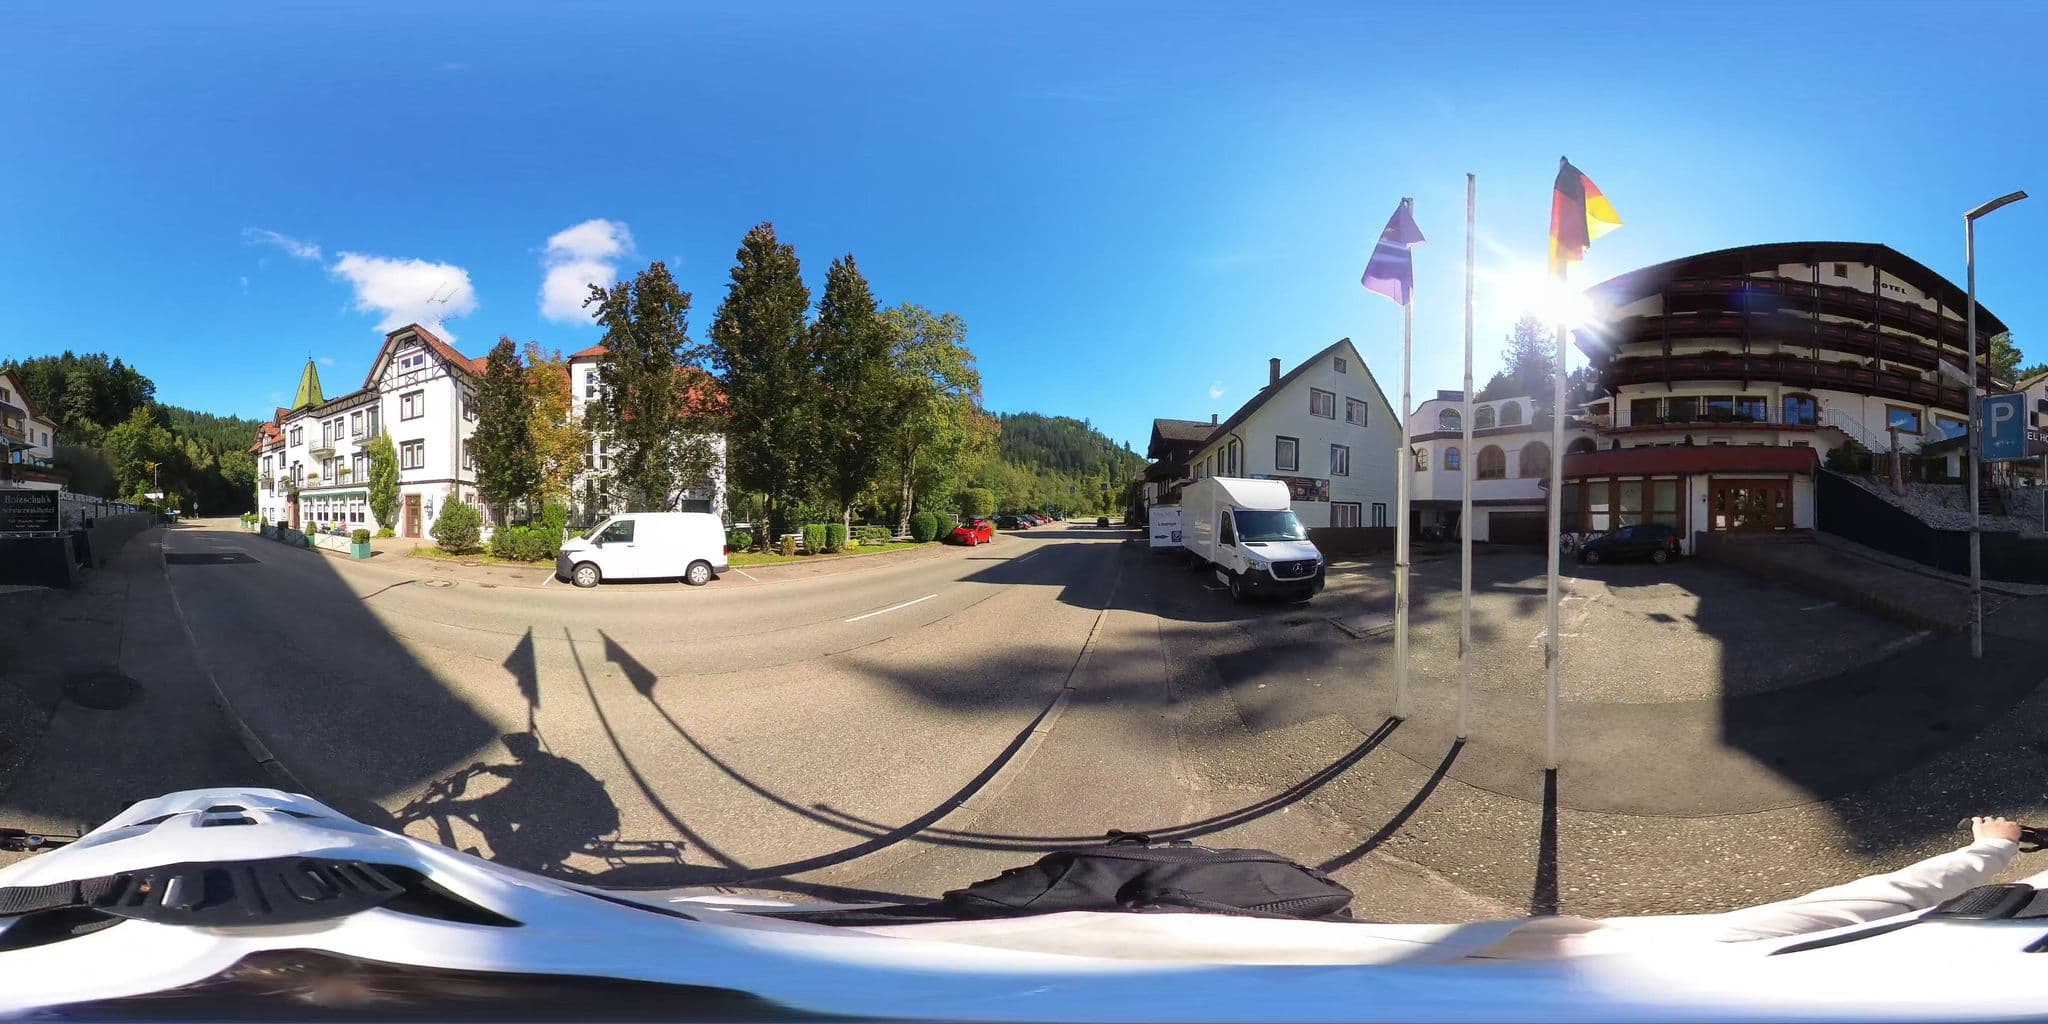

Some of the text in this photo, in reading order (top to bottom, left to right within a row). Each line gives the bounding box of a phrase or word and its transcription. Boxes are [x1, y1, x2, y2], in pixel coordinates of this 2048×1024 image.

[1881, 282, 1907, 295] OTEL
[1991, 402, 2014, 437] P
[2027, 431, 2038, 441] EL
